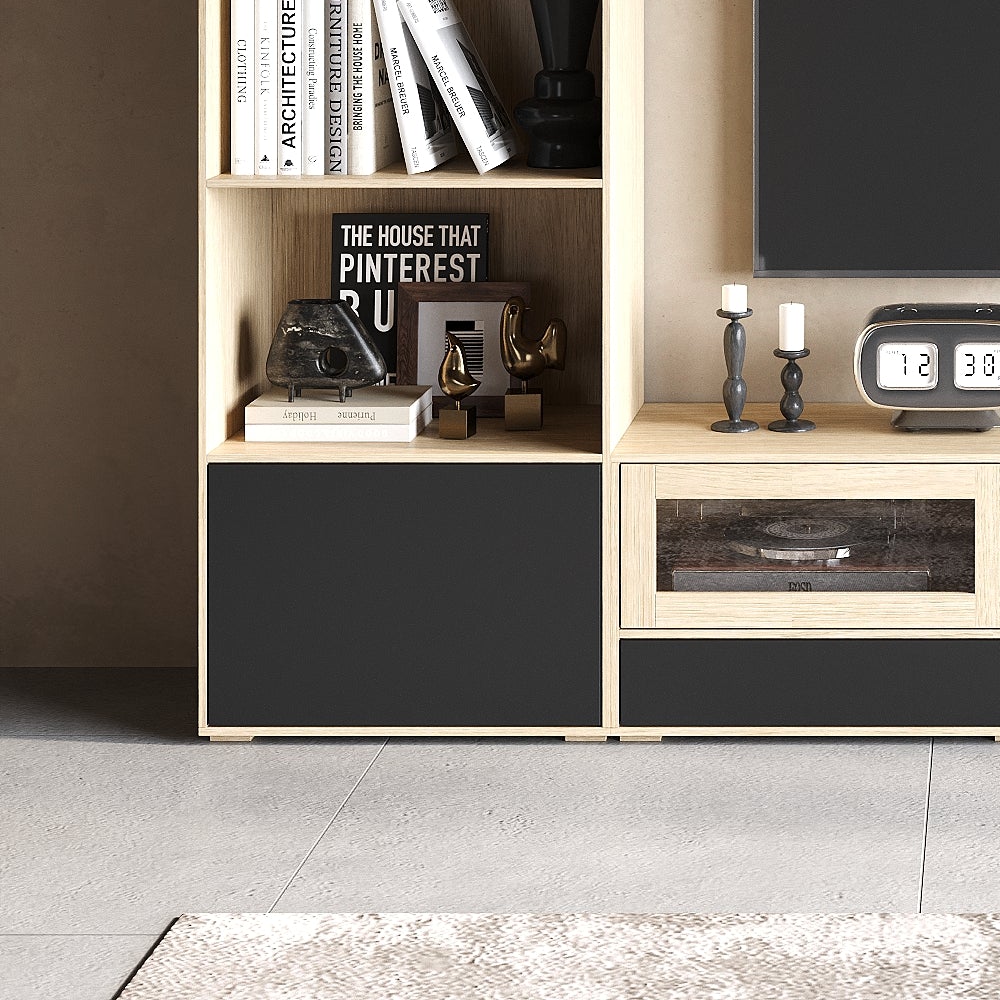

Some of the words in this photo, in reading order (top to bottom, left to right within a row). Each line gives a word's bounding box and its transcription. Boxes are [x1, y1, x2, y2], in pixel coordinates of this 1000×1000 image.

[352, 22, 363, 45] HOME
[260, 36, 270, 96] KINFOLK
[306, 27, 318, 77] Constructing
[352, 47, 363, 73] HOUSE
[237, 39, 247, 103] CLOTHING
[281, 0, 297, 149] ARCHITECTURE
[352, 75, 363, 91] THE
[389, 47, 403, 81] MARCEL
[396, 81, 410, 116] BREUER
[431, 54, 451, 88] MARCEL
[446, 86, 466, 119] BREUER
[352, 91, 363, 131] BRINGING
[328, 99, 342, 174] DESIGN
[341, 225, 373, 247] THE
[378, 225, 434, 247] HOUSE
[438, 225, 481, 247] THAT
[339, 253, 481, 283] PINTEREST
[901, 353, 930, 377] 12
[964, 353, 995, 377] 30
[283, 409, 317, 421] Holiday
[337, 411, 376, 421] Purienne
